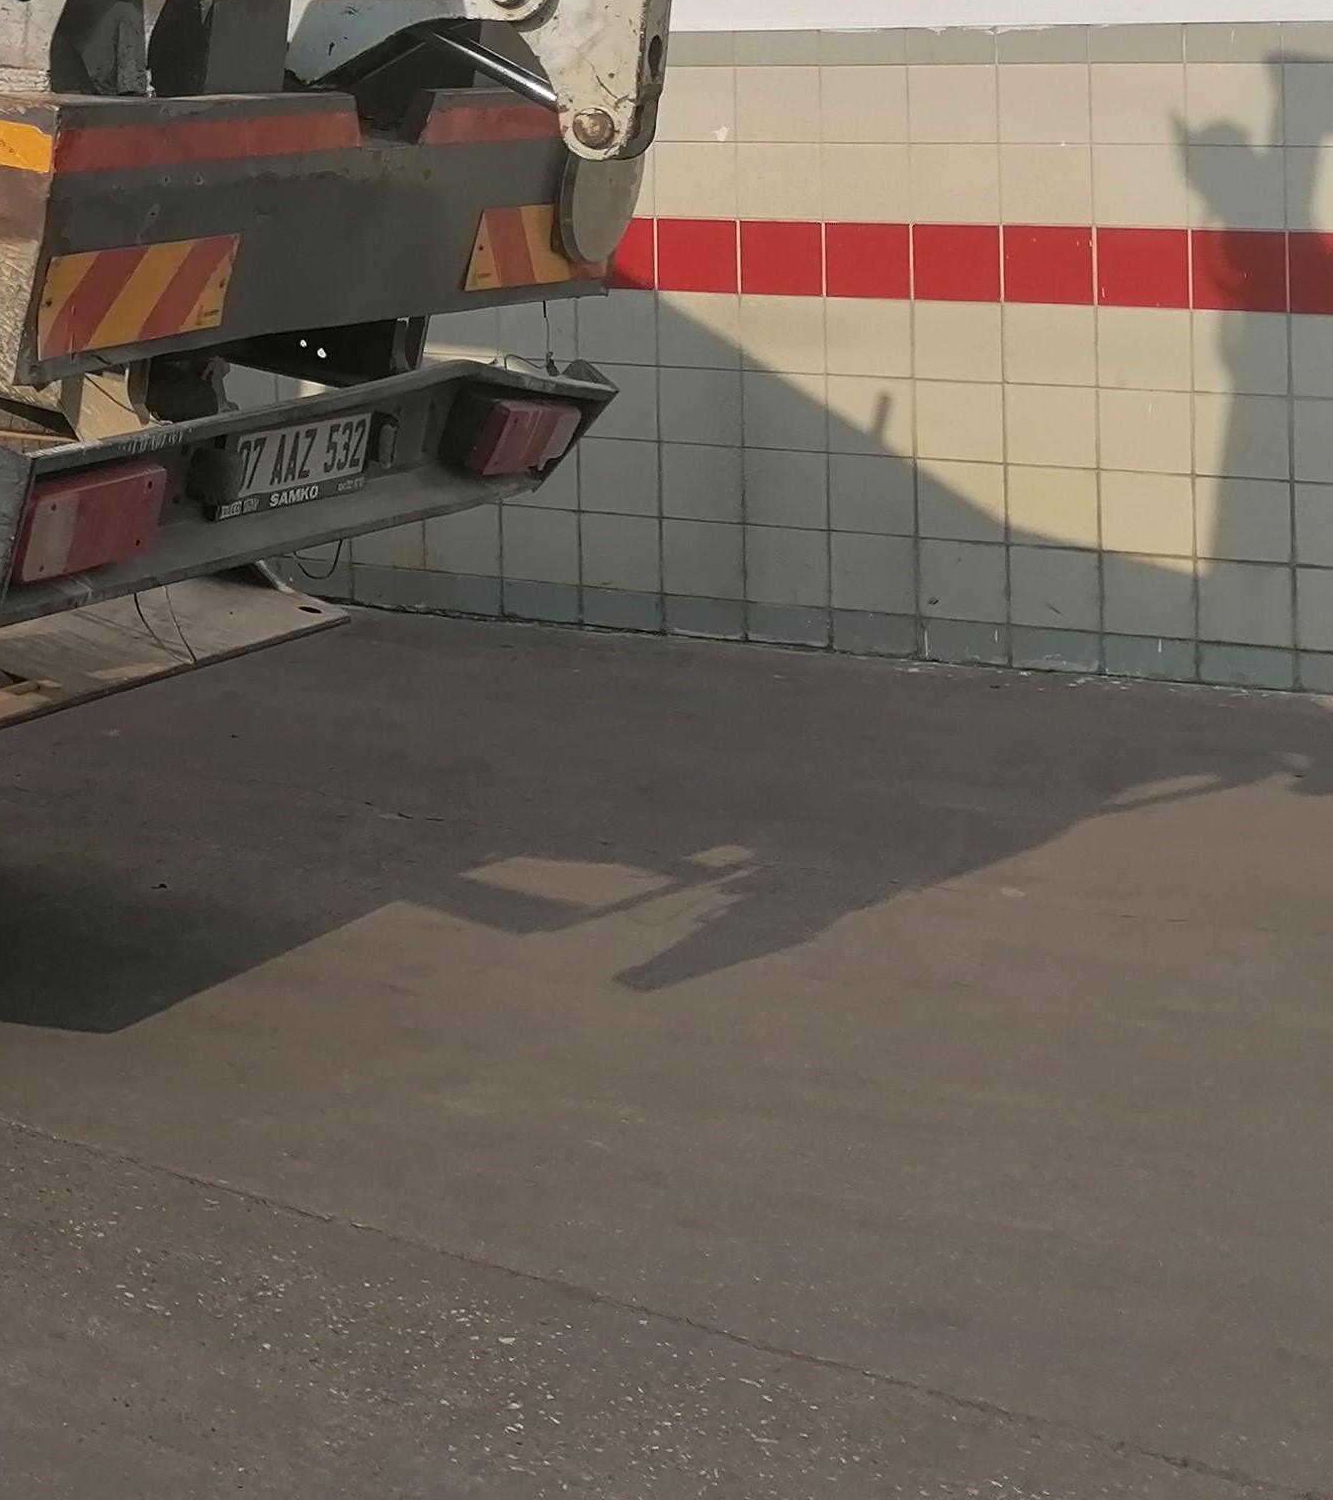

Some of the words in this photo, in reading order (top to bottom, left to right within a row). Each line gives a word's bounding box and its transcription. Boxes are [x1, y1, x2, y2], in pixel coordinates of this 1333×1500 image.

[270, 428, 318, 485] AAZ
[323, 418, 367, 474] 532
[269, 485, 319, 508] SAMKO
